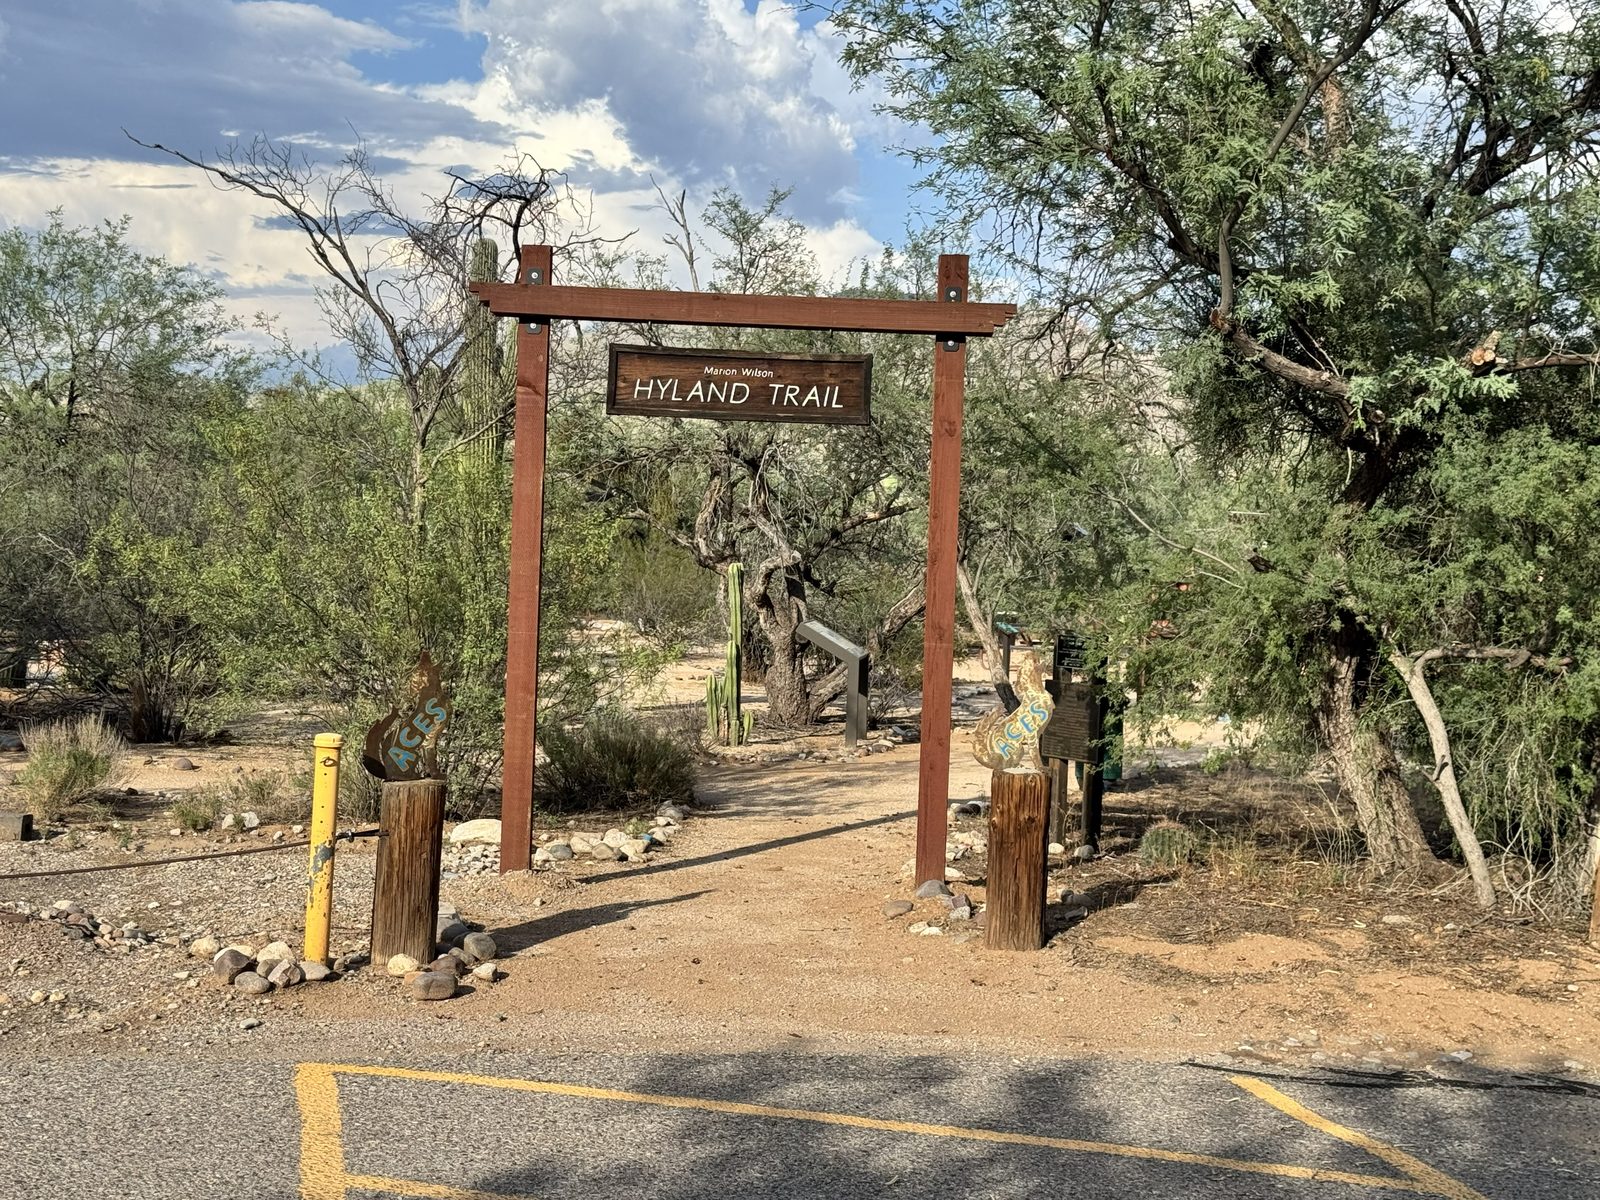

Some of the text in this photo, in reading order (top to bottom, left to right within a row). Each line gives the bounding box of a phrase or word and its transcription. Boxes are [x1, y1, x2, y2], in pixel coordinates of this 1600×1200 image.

[633, 378, 844, 409] HYLAND TRAIL
[703, 366, 774, 378] Marion Wilson
[387, 697, 447, 772] ACES
[993, 700, 1049, 760] ACES
